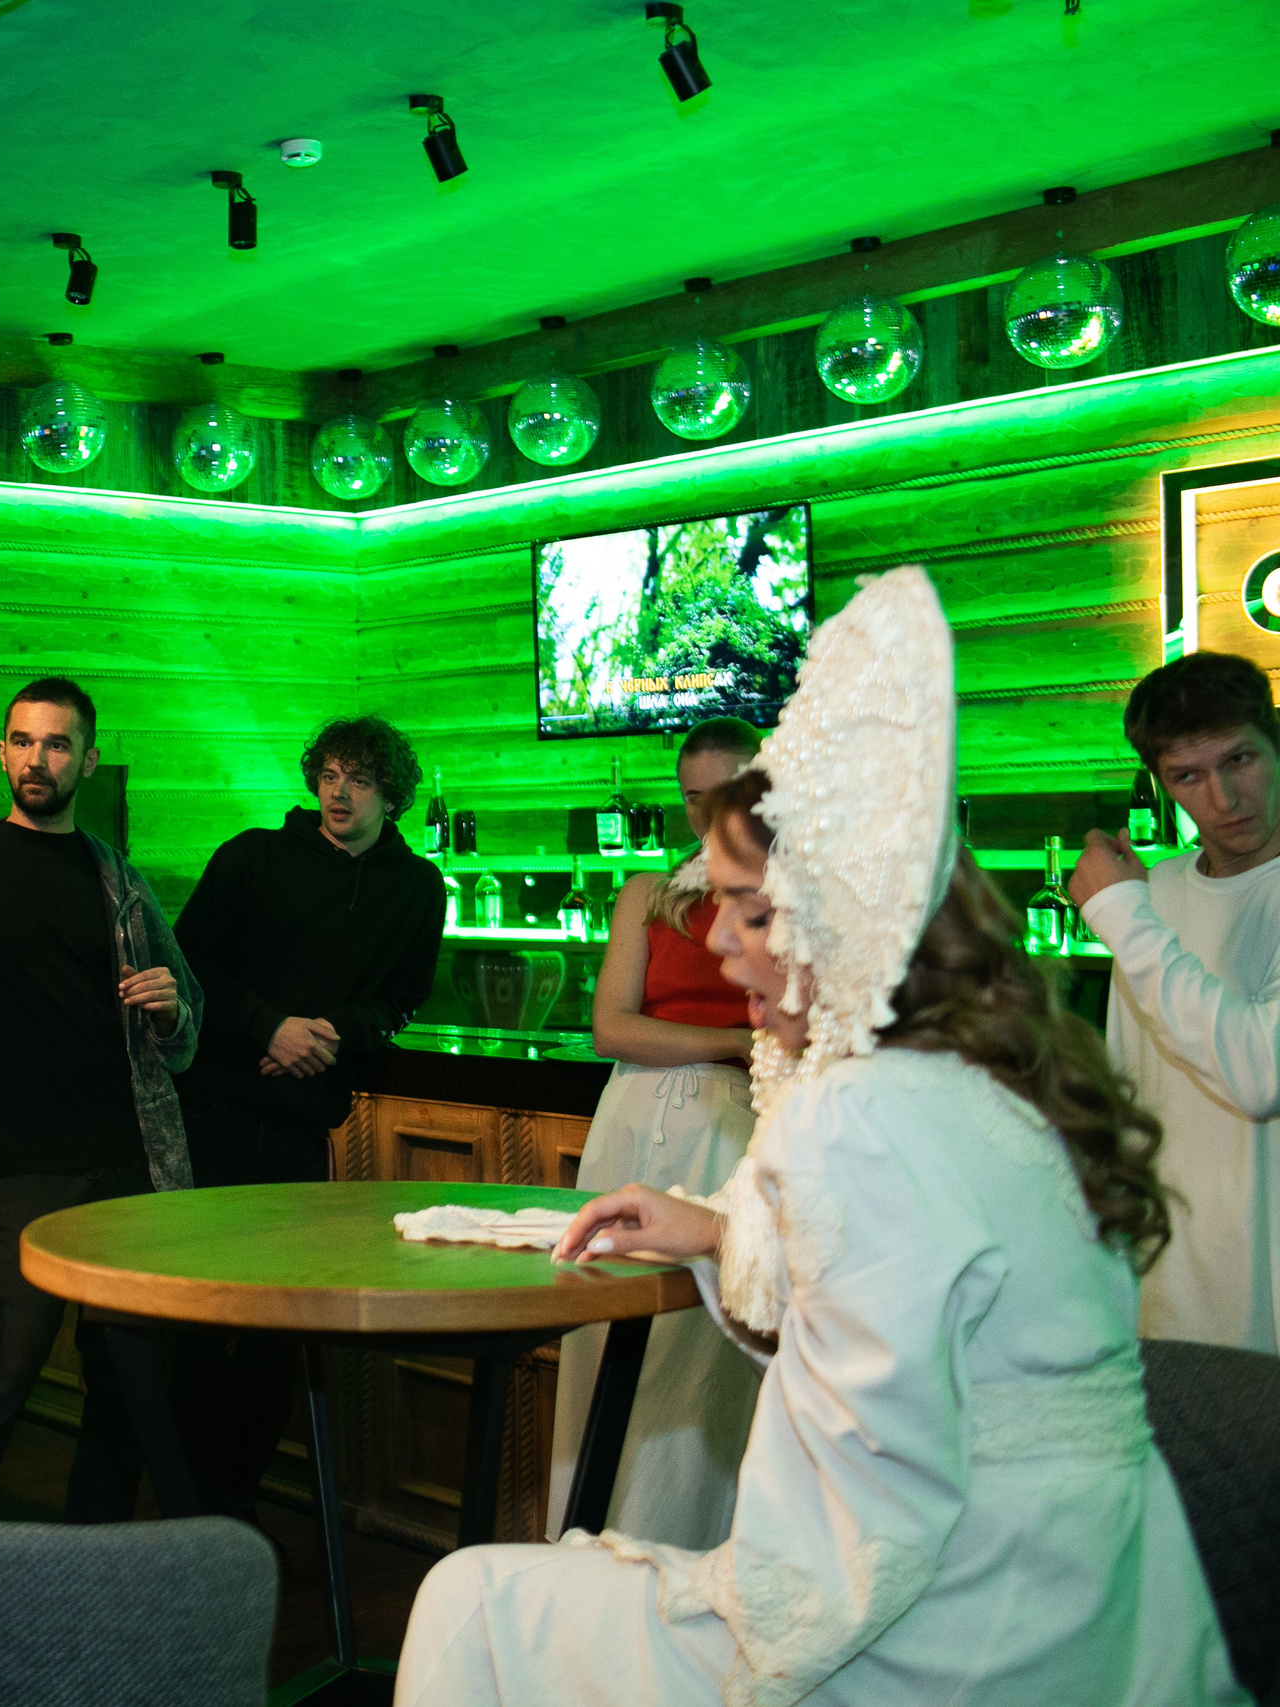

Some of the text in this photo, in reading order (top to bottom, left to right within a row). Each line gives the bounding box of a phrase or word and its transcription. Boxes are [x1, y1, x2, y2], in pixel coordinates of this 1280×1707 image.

[674, 671, 734, 690] КЛИПСАХ
[639, 692, 697, 709] ШЛА ОНА
